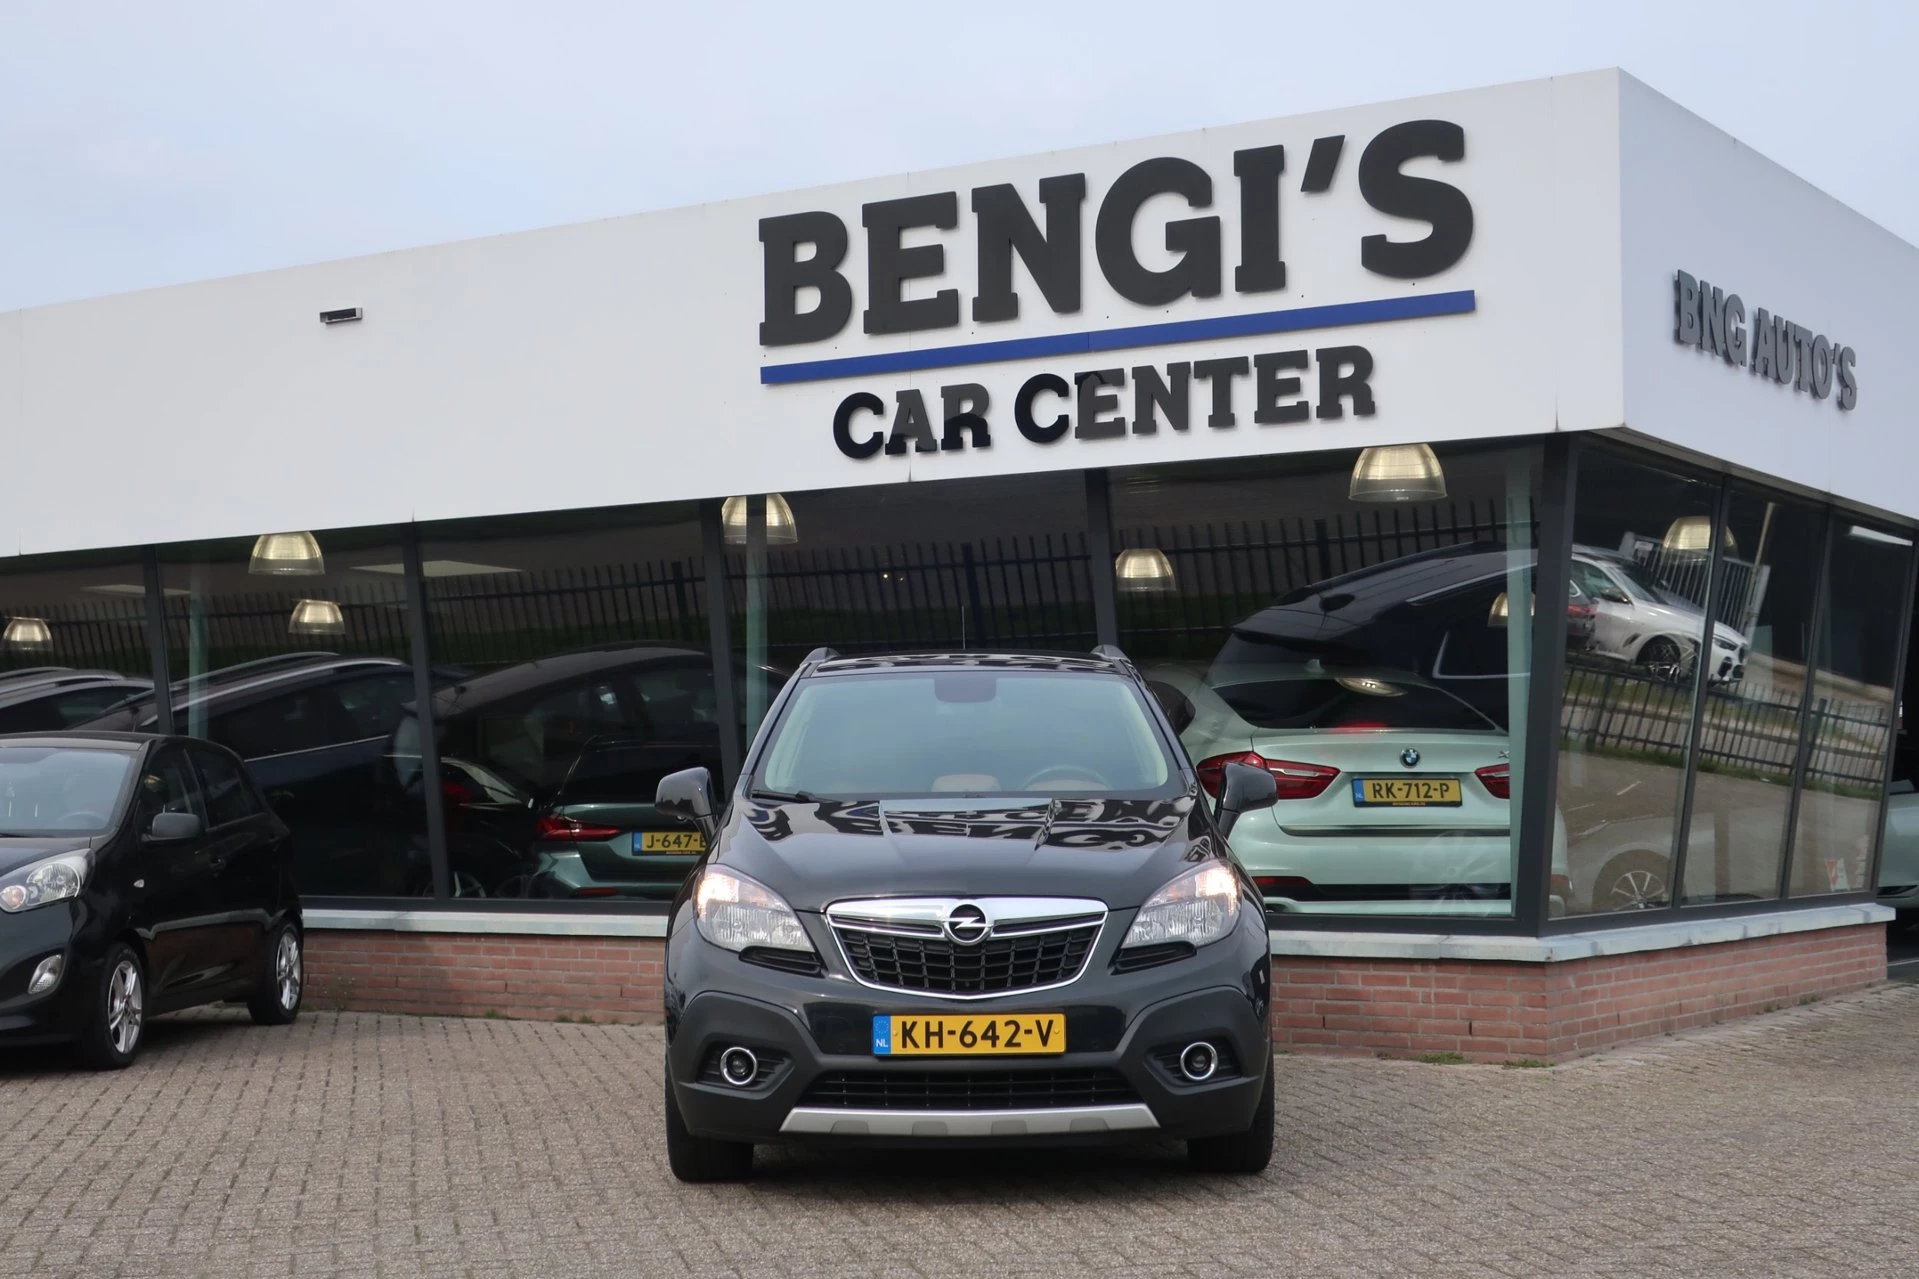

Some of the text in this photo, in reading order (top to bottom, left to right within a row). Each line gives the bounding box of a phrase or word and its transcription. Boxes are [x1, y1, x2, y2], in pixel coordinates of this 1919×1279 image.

[759, 119, 1474, 346] BENGI'S
[1674, 269, 1857, 412] BNG AUTO'S
[832, 345, 1376, 460] CAR CENTER
[1372, 783, 1450, 799] RK-712-P
[875, 1019, 1054, 1049] NL KH-642-V
